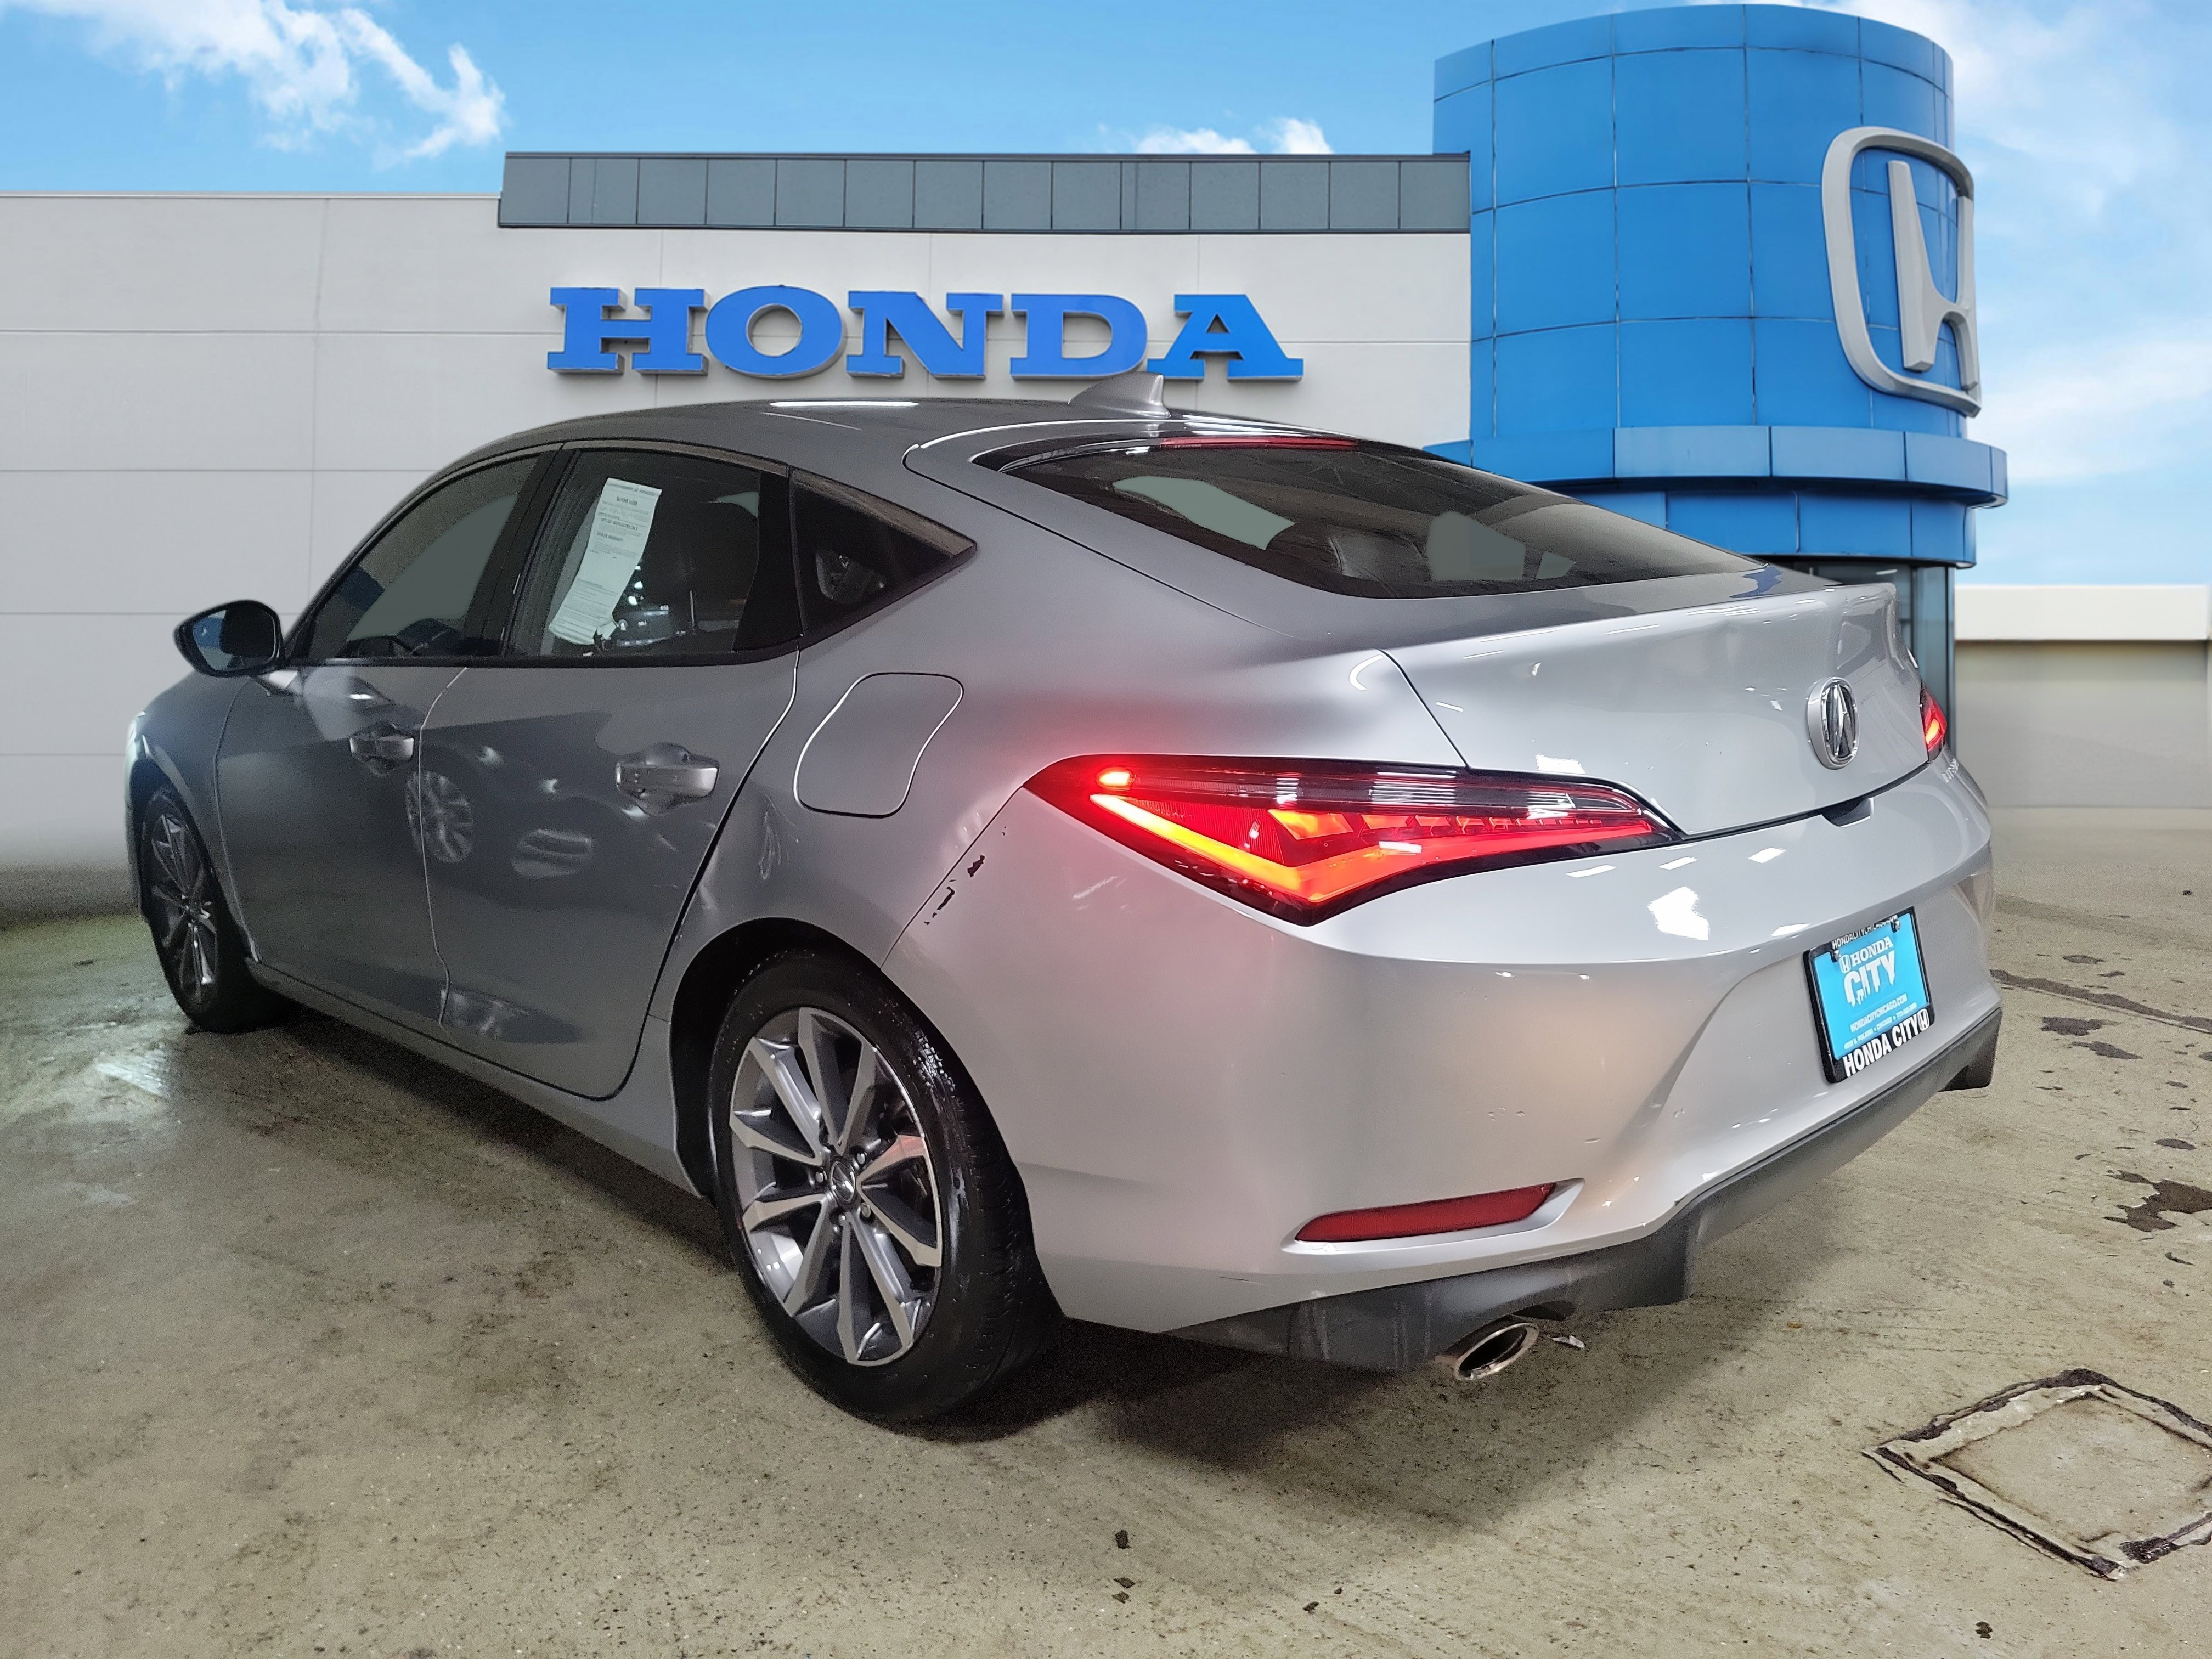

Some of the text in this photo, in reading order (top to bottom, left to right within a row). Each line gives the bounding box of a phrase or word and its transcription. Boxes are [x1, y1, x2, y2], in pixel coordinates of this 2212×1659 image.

[547, 285, 1304, 380] HONDA
[1844, 950, 1895, 1008] CITY
[1850, 936, 1894, 967] HONDA
[1842, 1033, 1892, 1077] HONDA
[1892, 1014, 1918, 1047] CITY
